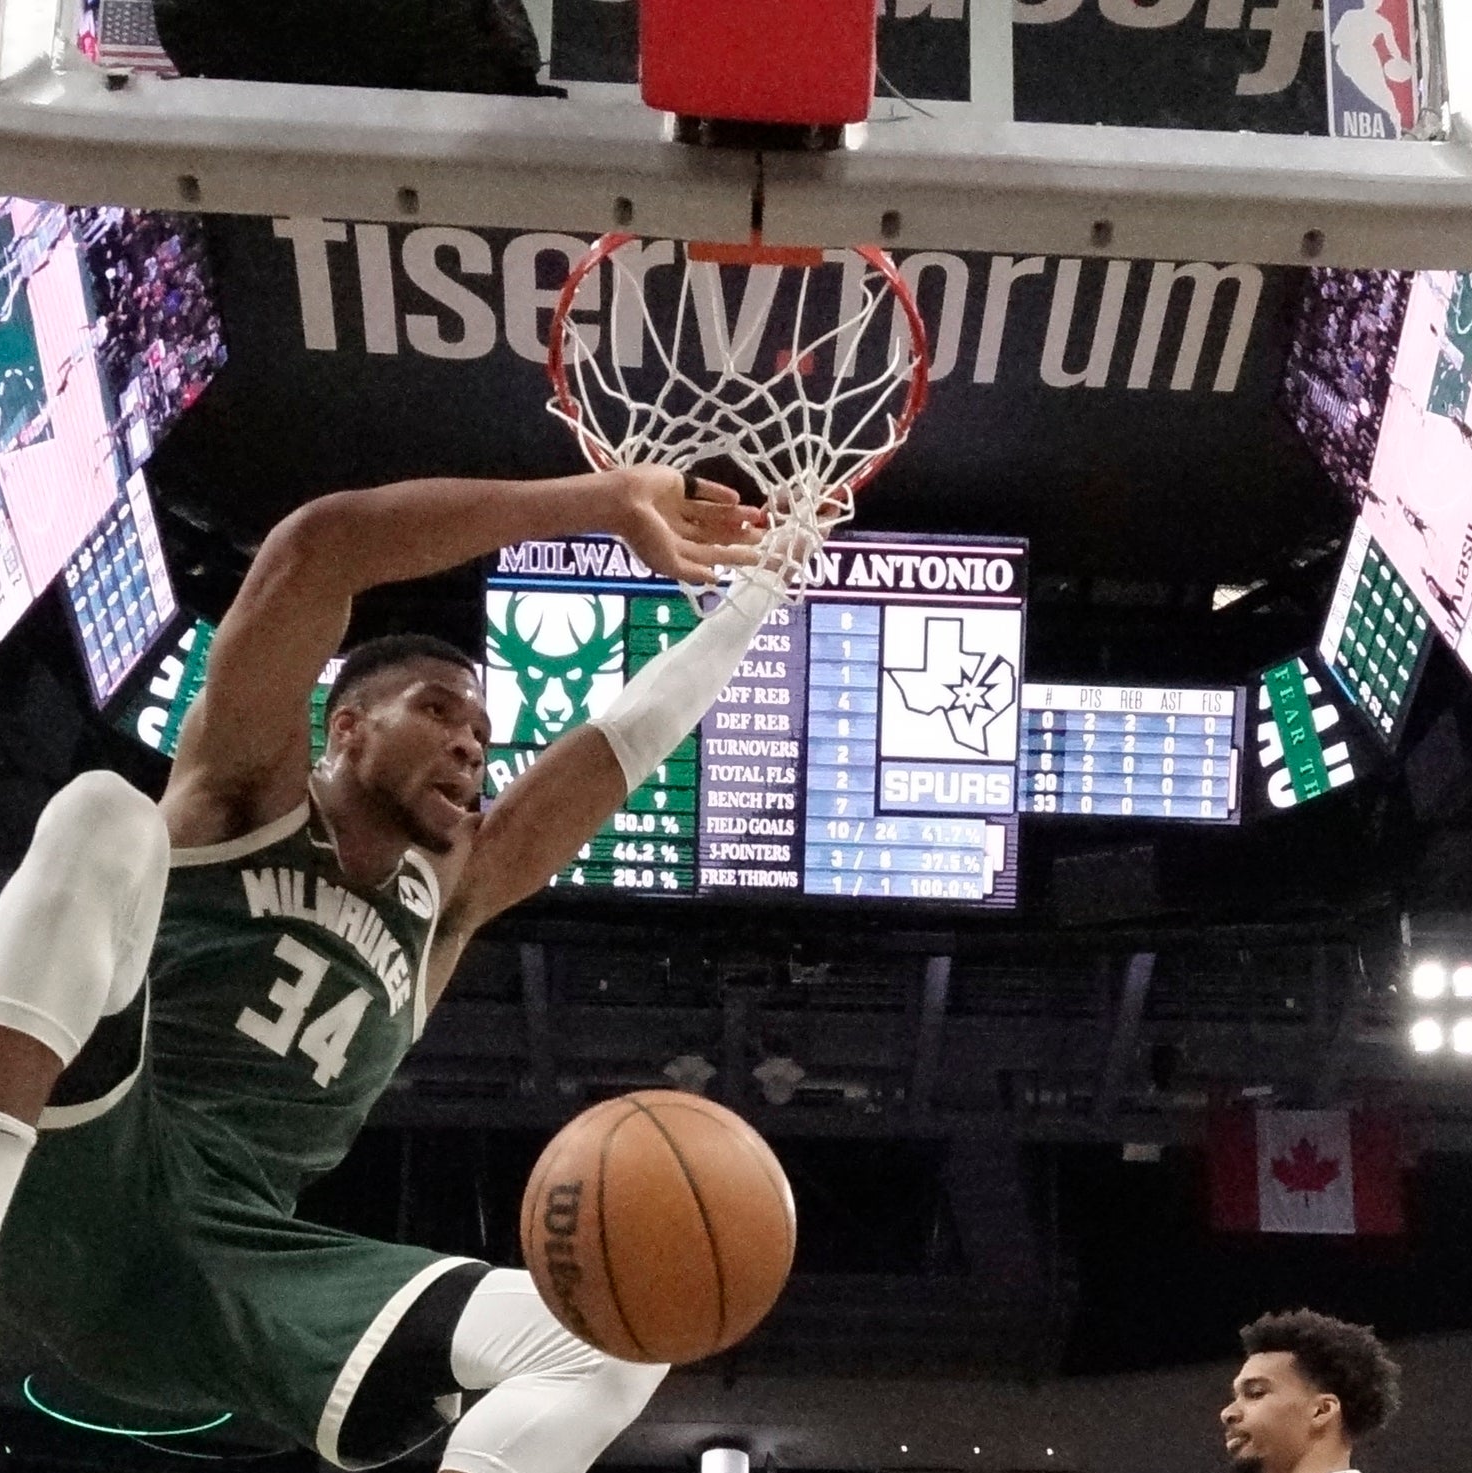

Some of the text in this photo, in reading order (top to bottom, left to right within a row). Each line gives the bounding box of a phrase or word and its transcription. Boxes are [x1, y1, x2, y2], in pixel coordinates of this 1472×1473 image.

[1342, 110, 1386, 139] NBA
[793, 552, 1015, 593] AN ANTONIO
[747, 635, 792, 653] OCKS
[732, 660, 787, 680] TEALS
[715, 687, 791, 706] OFF REB
[1079, 689, 1223, 713] PTS REB AST FLS
[1273, 666, 1306, 747] FEAR
[715, 713, 791, 732] DEF REB
[1083, 712, 1097, 731] 2
[1124, 713, 1137, 732] 2
[1165, 714, 1177, 733] 1
[706, 738, 800, 759] TURNOVERS
[1042, 731, 1053, 750] 1
[1083, 733, 1095, 752] 7
[1123, 734, 1136, 753] 2
[1205, 737, 1215, 755] 1
[837, 745, 850, 764] 2
[1082, 754, 1095, 773] 2
[656, 764, 667, 784] 1
[708, 764, 797, 785] TOTAL FLS
[836, 771, 850, 790] 2
[1033, 773, 1057, 792] 30
[1081, 775, 1094, 794] 3
[1124, 776, 1133, 795] 1
[883, 768, 1012, 807] SPURS
[706, 790, 796, 811] BENCH PTS
[836, 797, 849, 816] 7
[1033, 794, 1056, 813] 33
[1163, 798, 1173, 816] 1
[706, 816, 796, 838] FIELD GOALS
[826, 820, 850, 841] 10
[875, 822, 898, 843] 24
[709, 842, 791, 863] 3-POINTERS
[830, 849, 844, 869] 3
[700, 868, 799, 890] FREE THROWS
[831, 876, 843, 896] 1
[880, 877, 892, 897] 1
[241, 867, 413, 1018] MILWAUKEE
[234, 933, 375, 1089] 34
